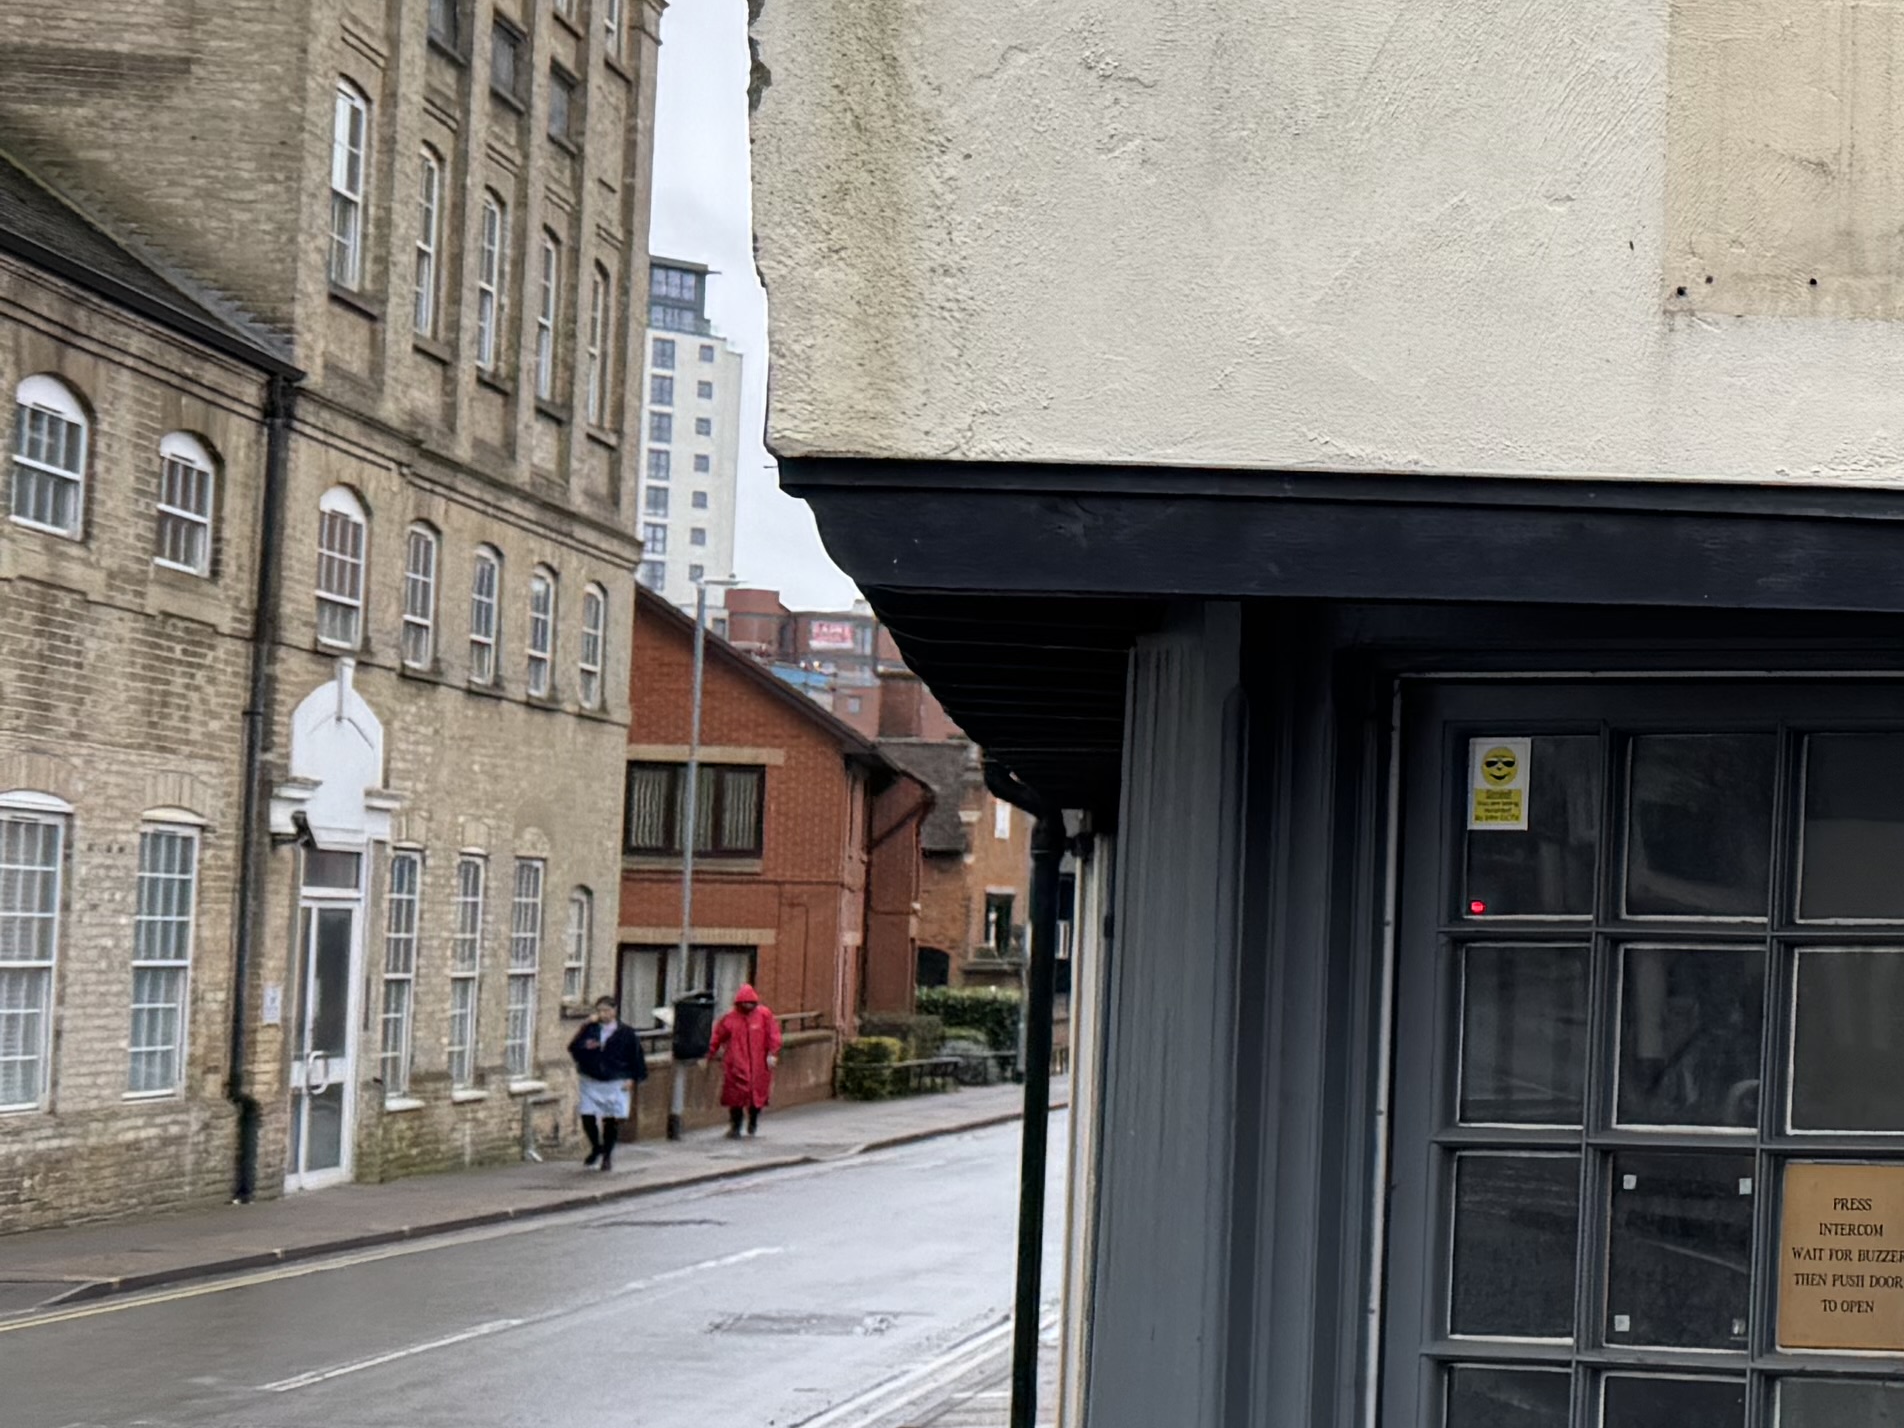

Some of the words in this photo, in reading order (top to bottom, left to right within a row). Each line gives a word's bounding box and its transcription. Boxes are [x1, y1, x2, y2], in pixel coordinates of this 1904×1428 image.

[1833, 1197, 1873, 1211] PRESS
[1819, 1222, 1883, 1237] INTERCOM
[1792, 1247, 1825, 1261] WAIT
[1828, 1248, 1853, 1262] FOR
[1793, 1273, 1827, 1287] THEN
[1832, 1274, 1865, 1288] PUSH
[1869, 1275, 1904, 1289] DOOR
[1821, 1299, 1838, 1312] TO
[1840, 1300, 1875, 1313] OPEN
